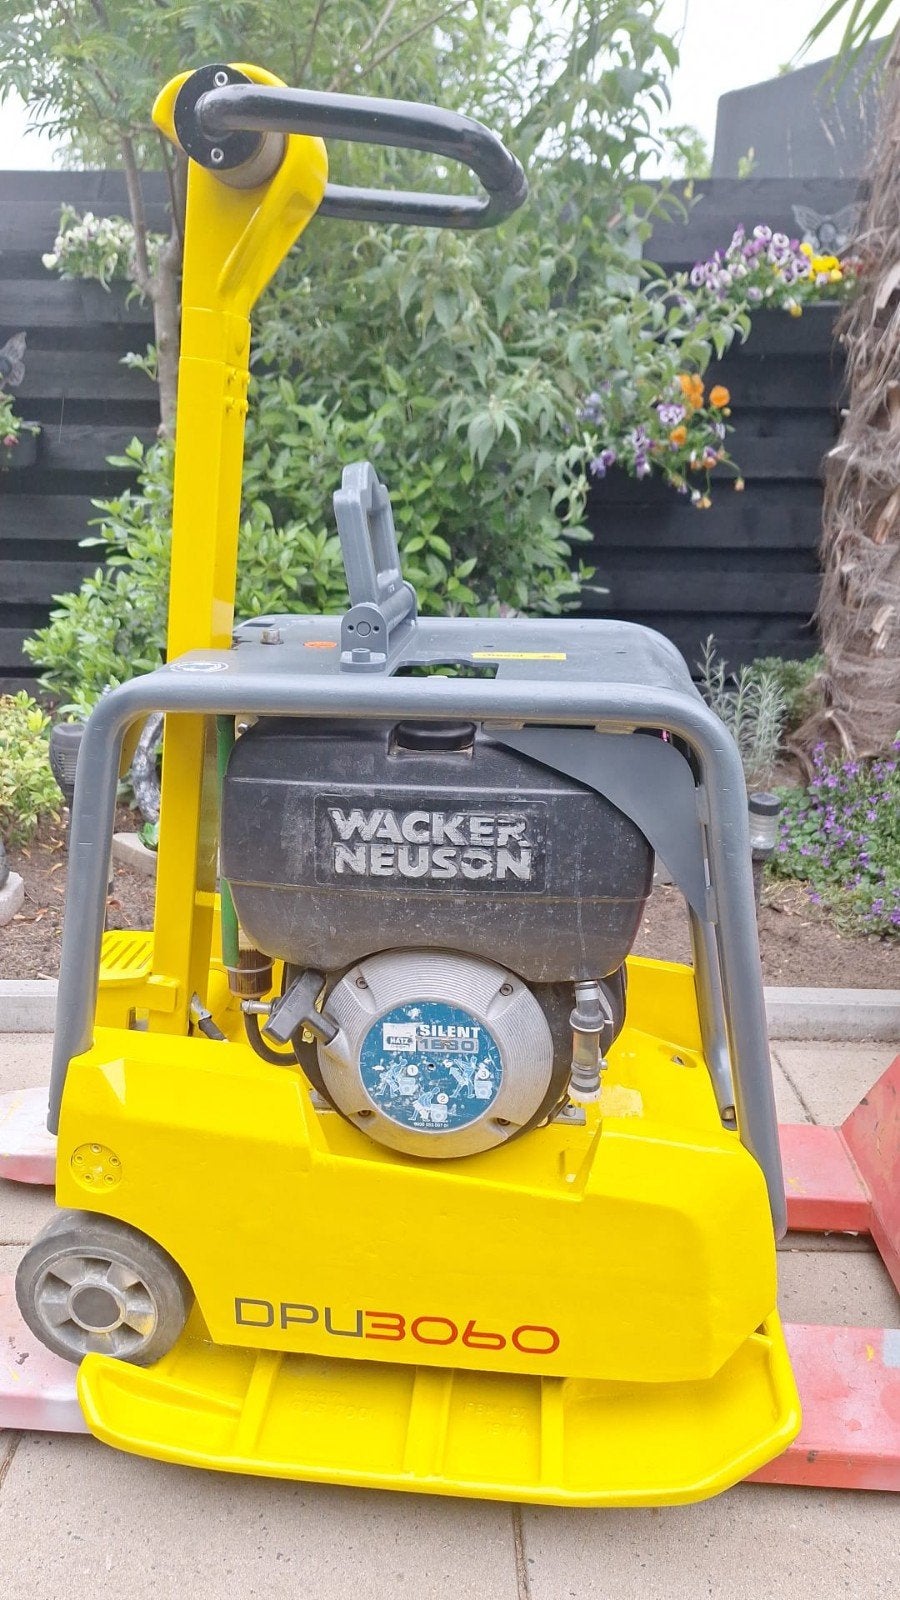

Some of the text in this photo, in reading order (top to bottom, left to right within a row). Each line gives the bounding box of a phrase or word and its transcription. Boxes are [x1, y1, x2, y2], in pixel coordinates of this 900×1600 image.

[328, 807, 532, 847] WACKER
[332, 843, 532, 881] NEUSON
[390, 1036, 409, 1045] HATZ
[419, 1024, 481, 1039] SILENT
[234, 1297, 560, 1355] DPU3060
